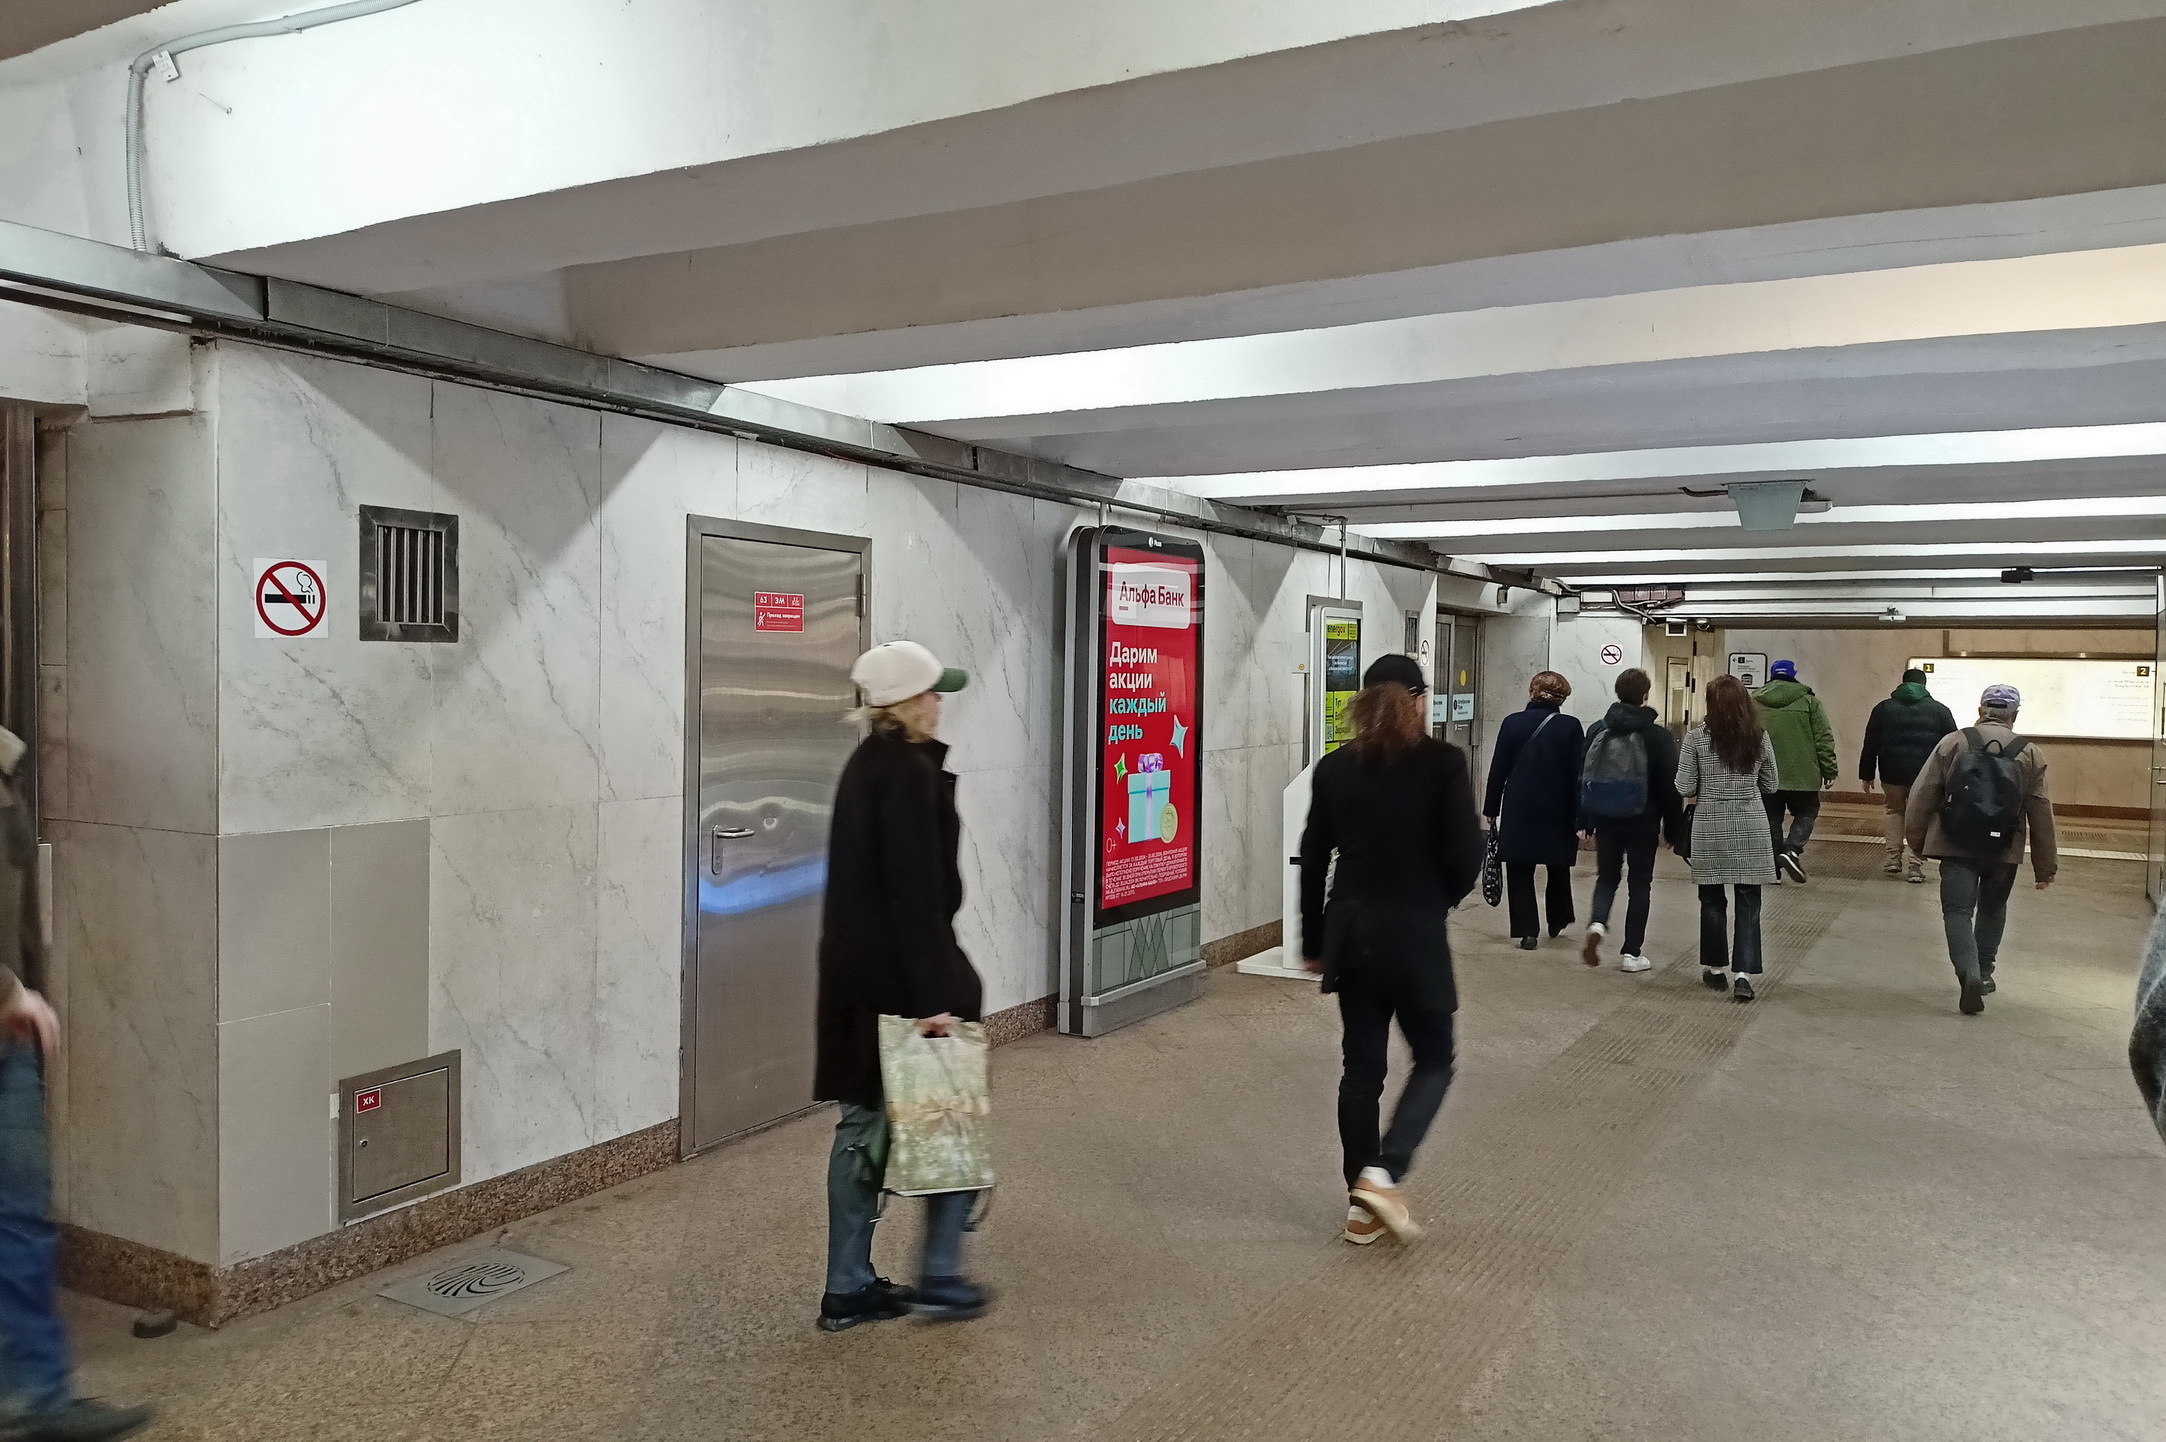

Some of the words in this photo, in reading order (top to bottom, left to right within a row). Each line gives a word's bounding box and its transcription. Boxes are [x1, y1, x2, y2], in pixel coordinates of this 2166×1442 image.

[1120, 581, 1156, 608] Альфа
[1158, 586, 1184, 607] Банк
[1109, 642, 1157, 668] Дарим
[1925, 664, 1932, 672] 1
[2140, 667, 2147, 675] 2
[1109, 672, 1152, 692] акции
[1109, 691, 1167, 717] каждый
[1108, 724, 1144, 745] день
[1106, 837, 1117, 853] 0+
